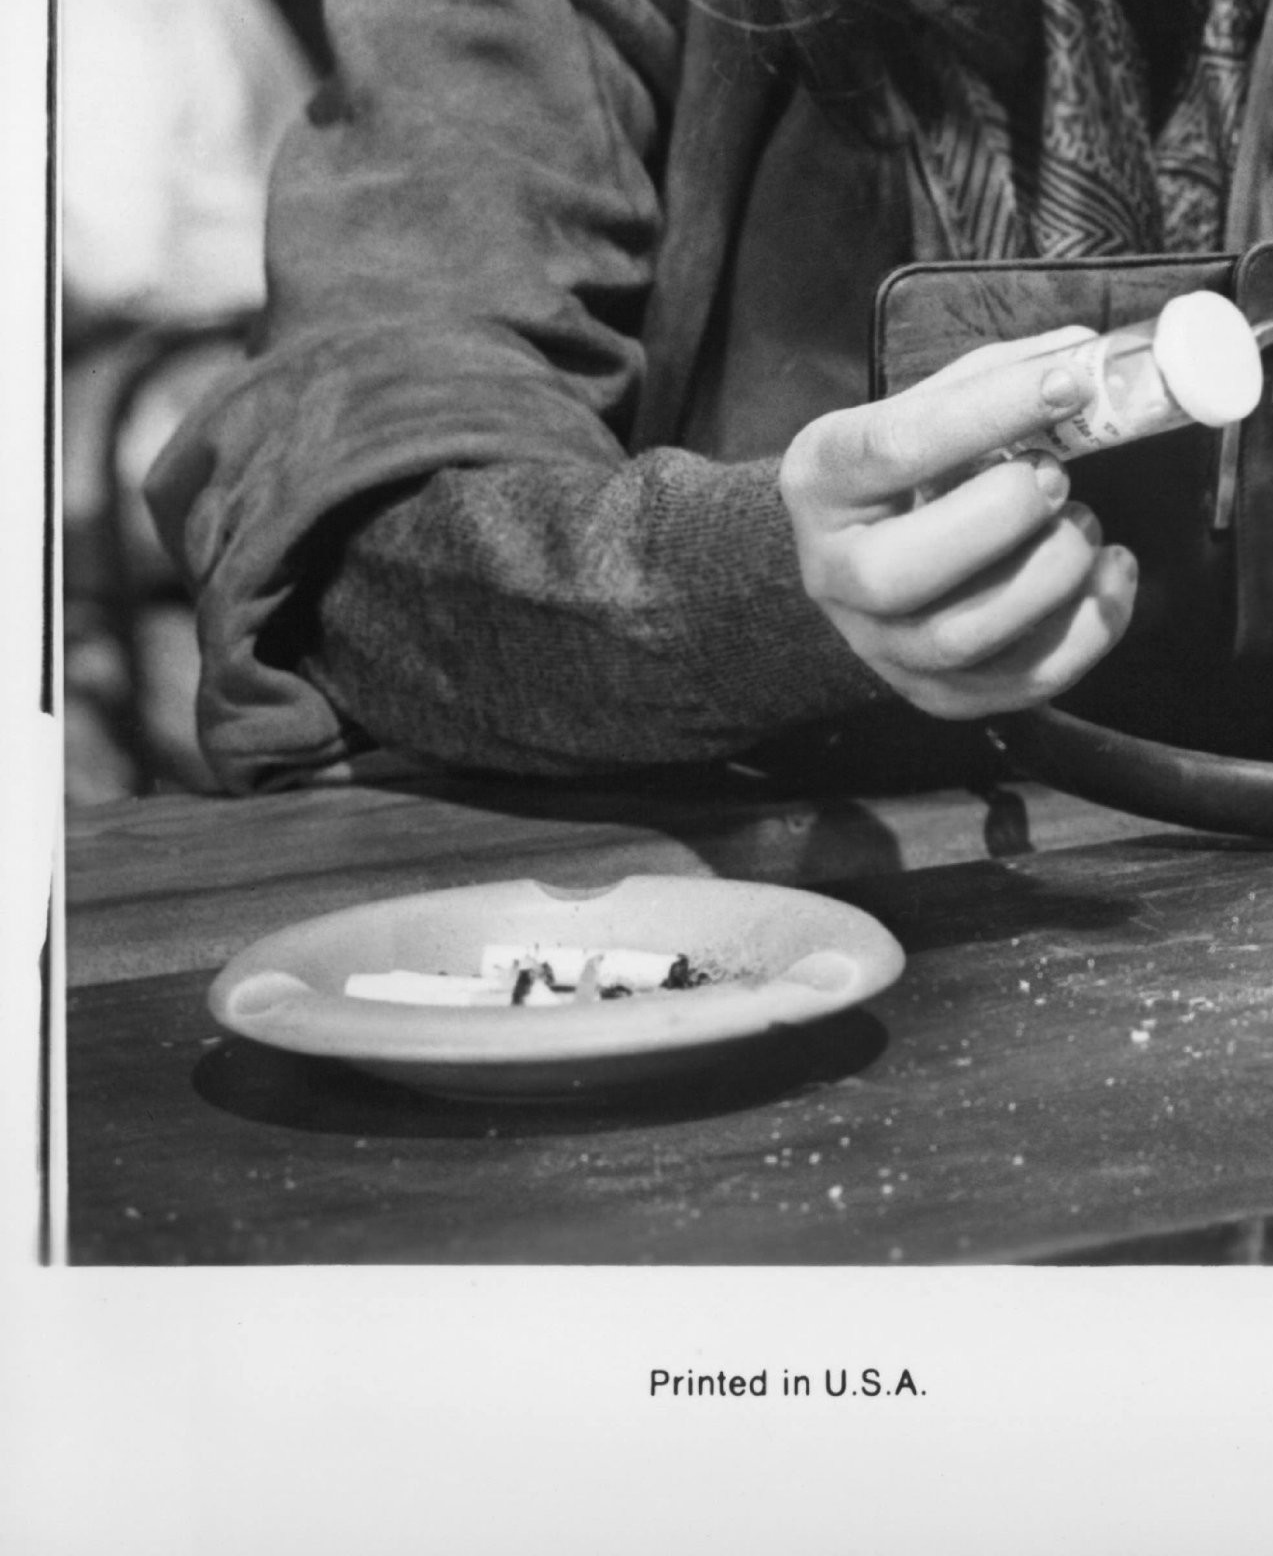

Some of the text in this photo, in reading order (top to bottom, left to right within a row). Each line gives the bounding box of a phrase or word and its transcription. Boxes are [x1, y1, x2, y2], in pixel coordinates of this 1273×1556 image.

[650, 1368, 926, 1397] Printed in U.S.A.
